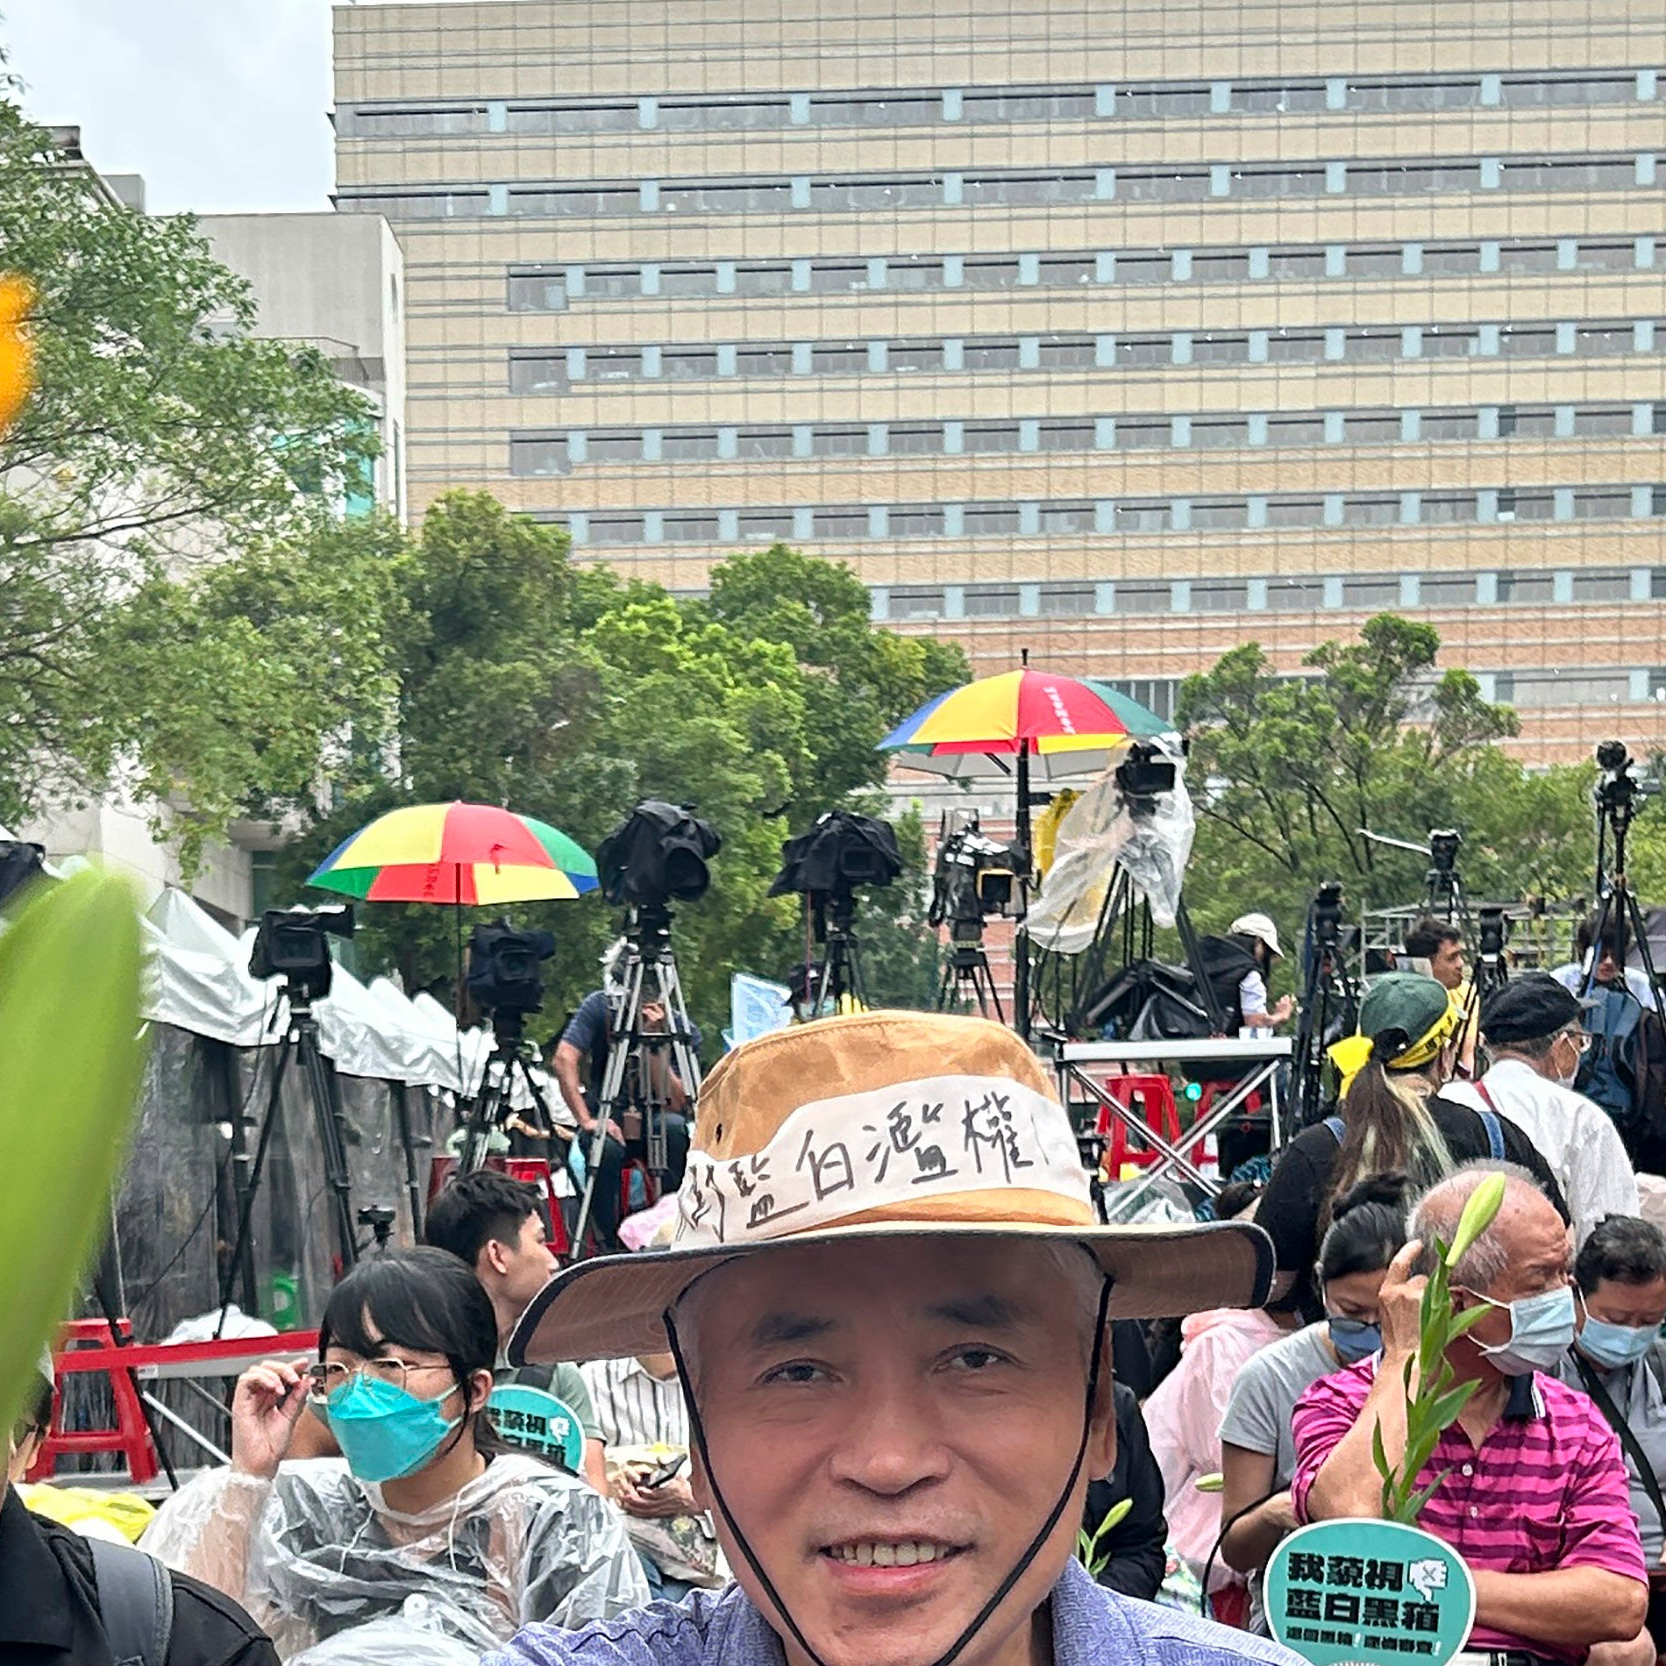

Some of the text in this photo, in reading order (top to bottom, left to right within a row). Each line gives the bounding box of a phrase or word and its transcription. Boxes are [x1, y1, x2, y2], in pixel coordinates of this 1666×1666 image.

[1288, 1552, 1404, 1592] 我藐視
[1285, 1588, 1440, 1633] 藍白黑箱
